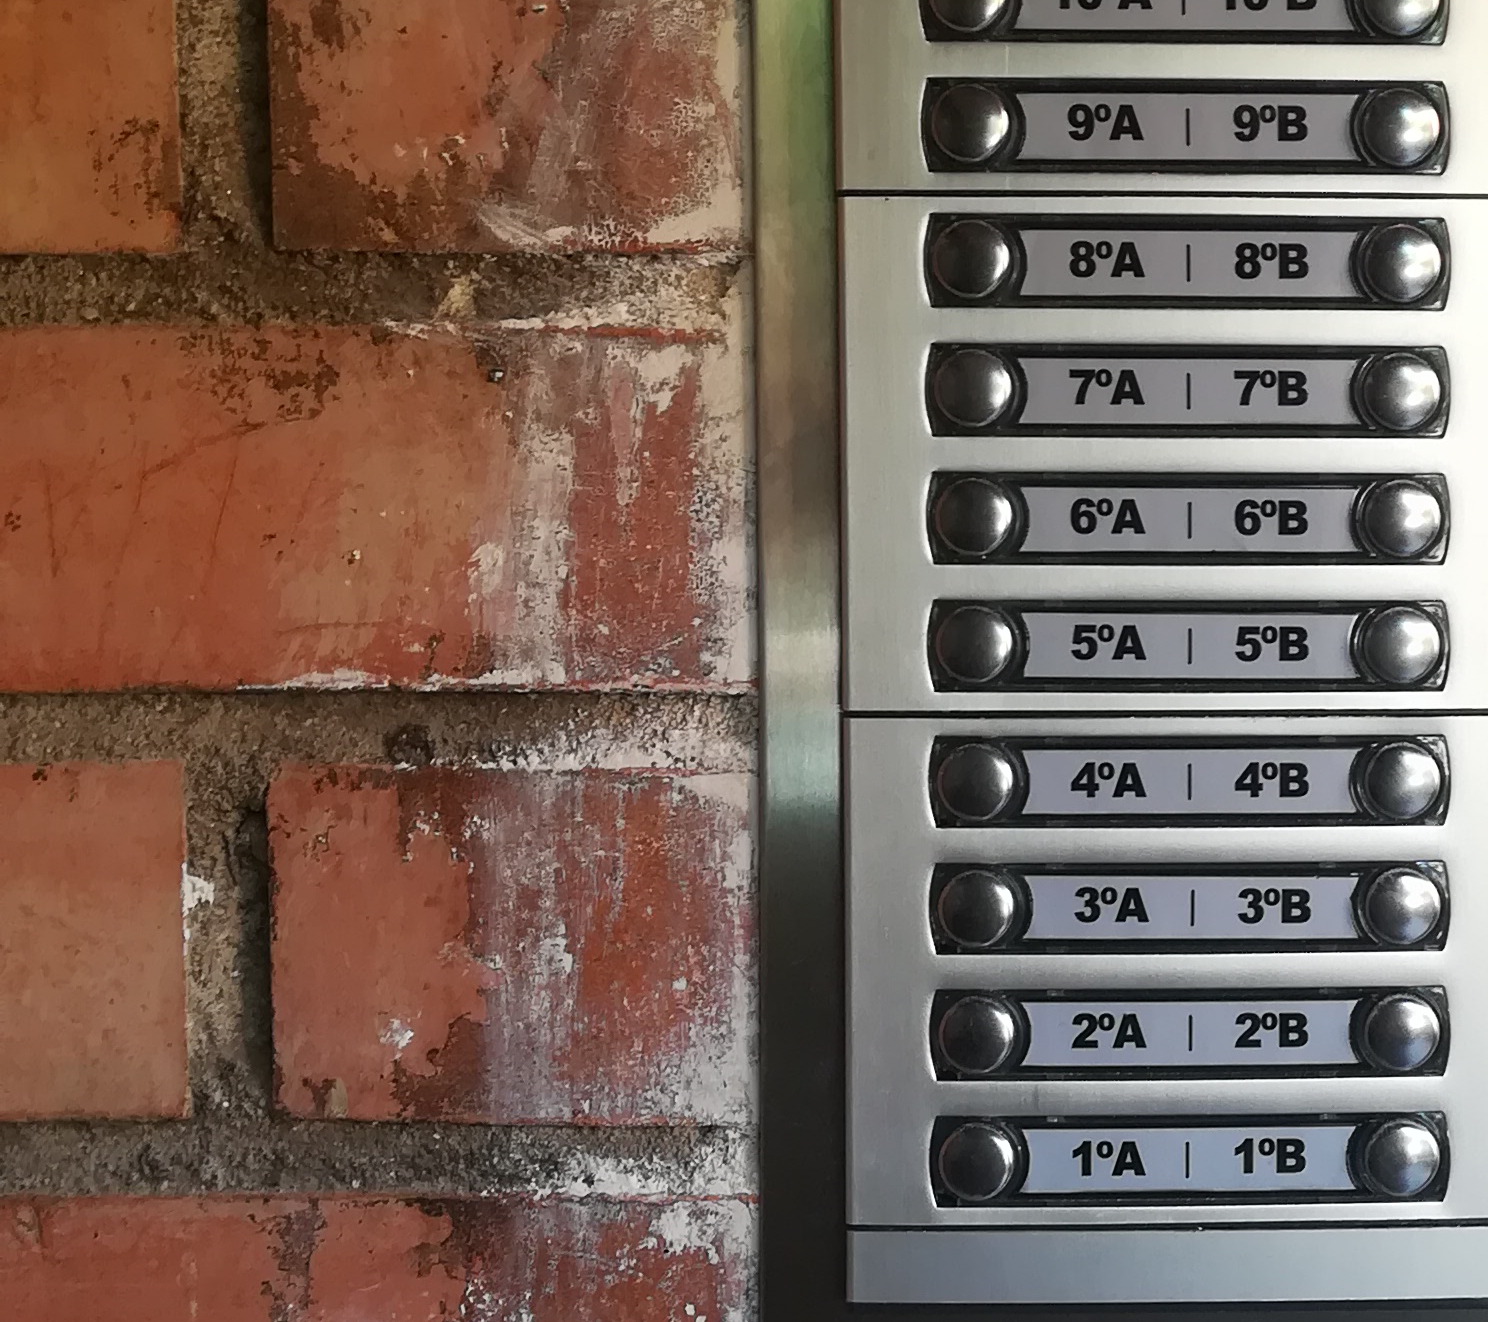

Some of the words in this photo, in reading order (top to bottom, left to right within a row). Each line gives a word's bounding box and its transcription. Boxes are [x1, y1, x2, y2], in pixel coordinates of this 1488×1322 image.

[1068, 104, 1143, 140] 9ºA
[1233, 105, 1307, 141] 9ºB
[1070, 241, 1144, 277] 8ºA
[1235, 243, 1308, 279] 8ºB
[1069, 369, 1144, 405] 7ºA
[1234, 370, 1307, 406] 7ºB
[1071, 498, 1145, 534] 6ºA
[1235, 500, 1308, 535] 6ºB
[1072, 624, 1146, 660] 5ºA
[1236, 626, 1308, 661] 5ºB
[1071, 762, 1146, 797] 4ºA
[1235, 762, 1309, 797] 4ºB
[1075, 887, 1148, 922] 3ºA
[1238, 888, 1311, 924] 3ºB
[1072, 1013, 1146, 1048] 2ºA
[1235, 1013, 1308, 1048] 2ºB
[1073, 1141, 1145, 1176] 1ºA
[1235, 1138, 1305, 1173] 1ºB
